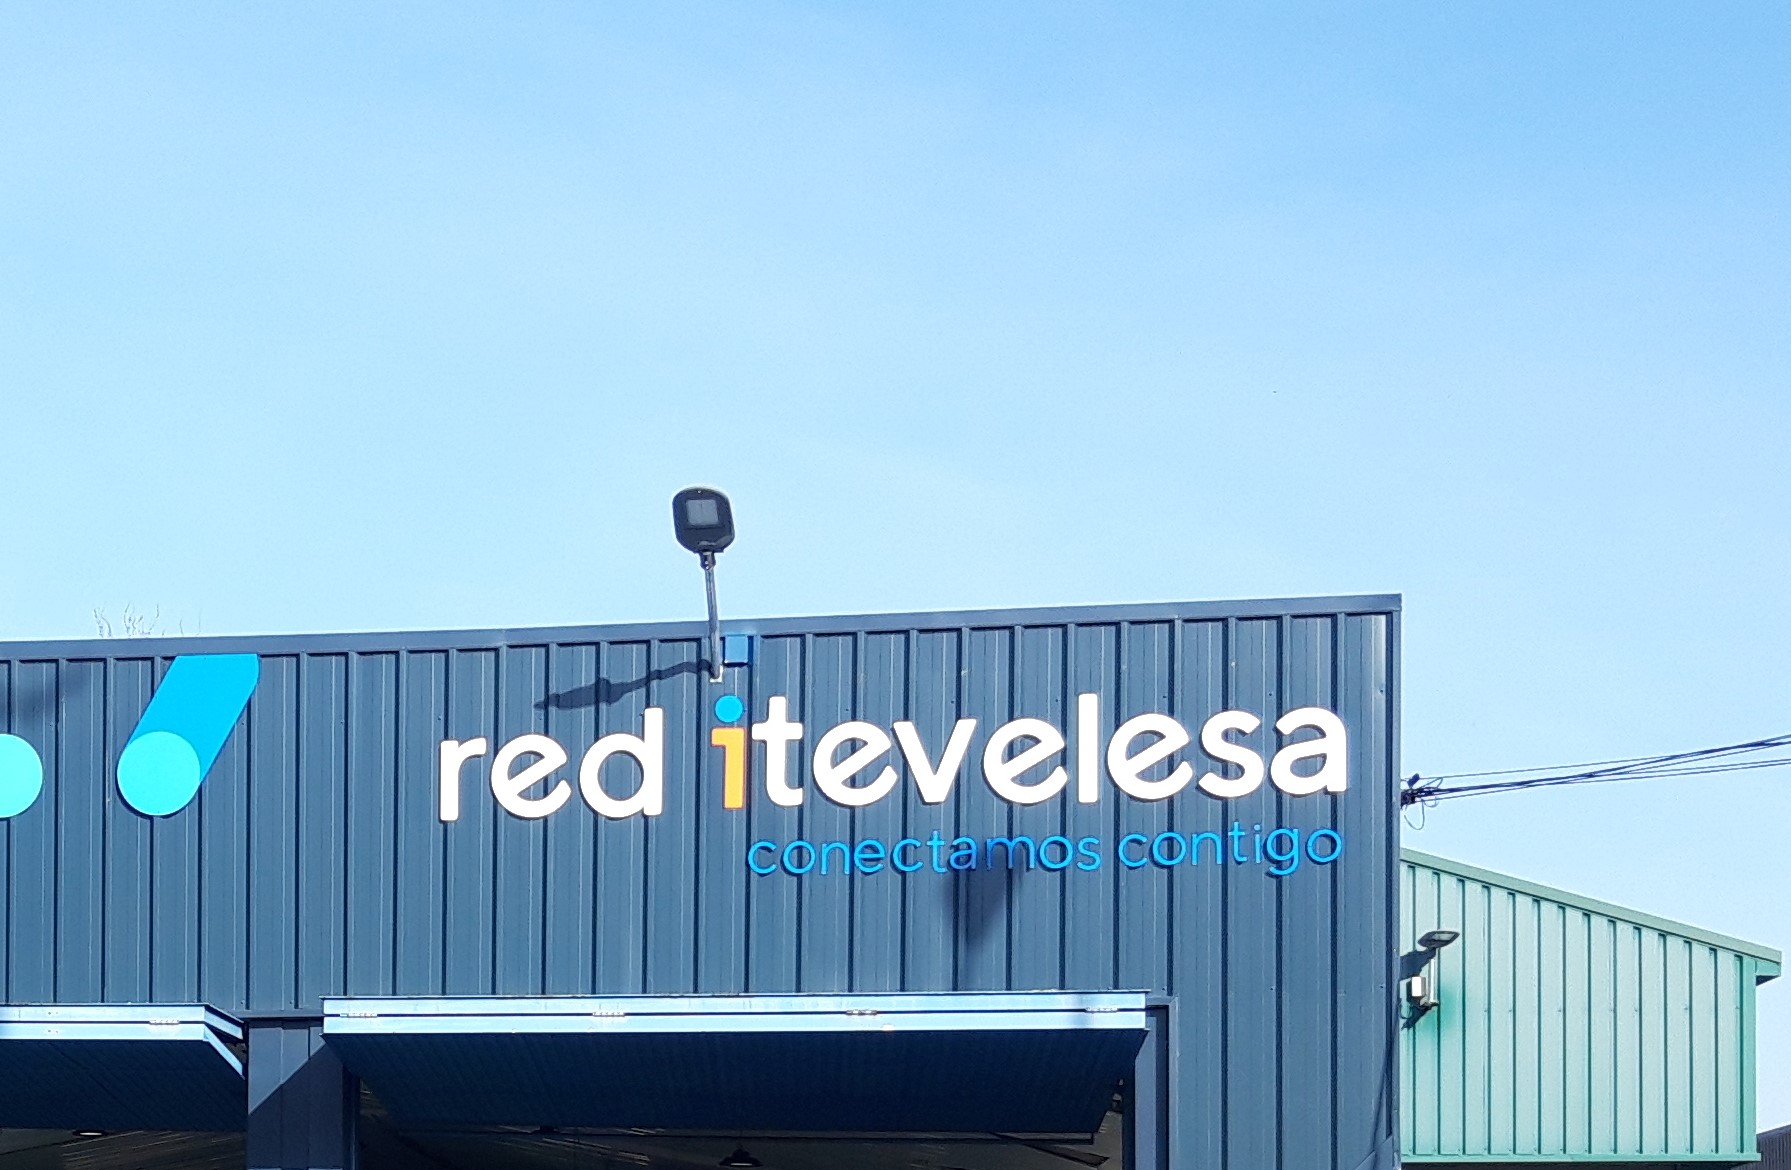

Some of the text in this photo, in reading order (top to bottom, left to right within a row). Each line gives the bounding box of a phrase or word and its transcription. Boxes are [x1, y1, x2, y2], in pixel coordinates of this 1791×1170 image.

[439, 692, 1348, 822] red itevelesa
[746, 821, 1344, 877] conectamos contigo
